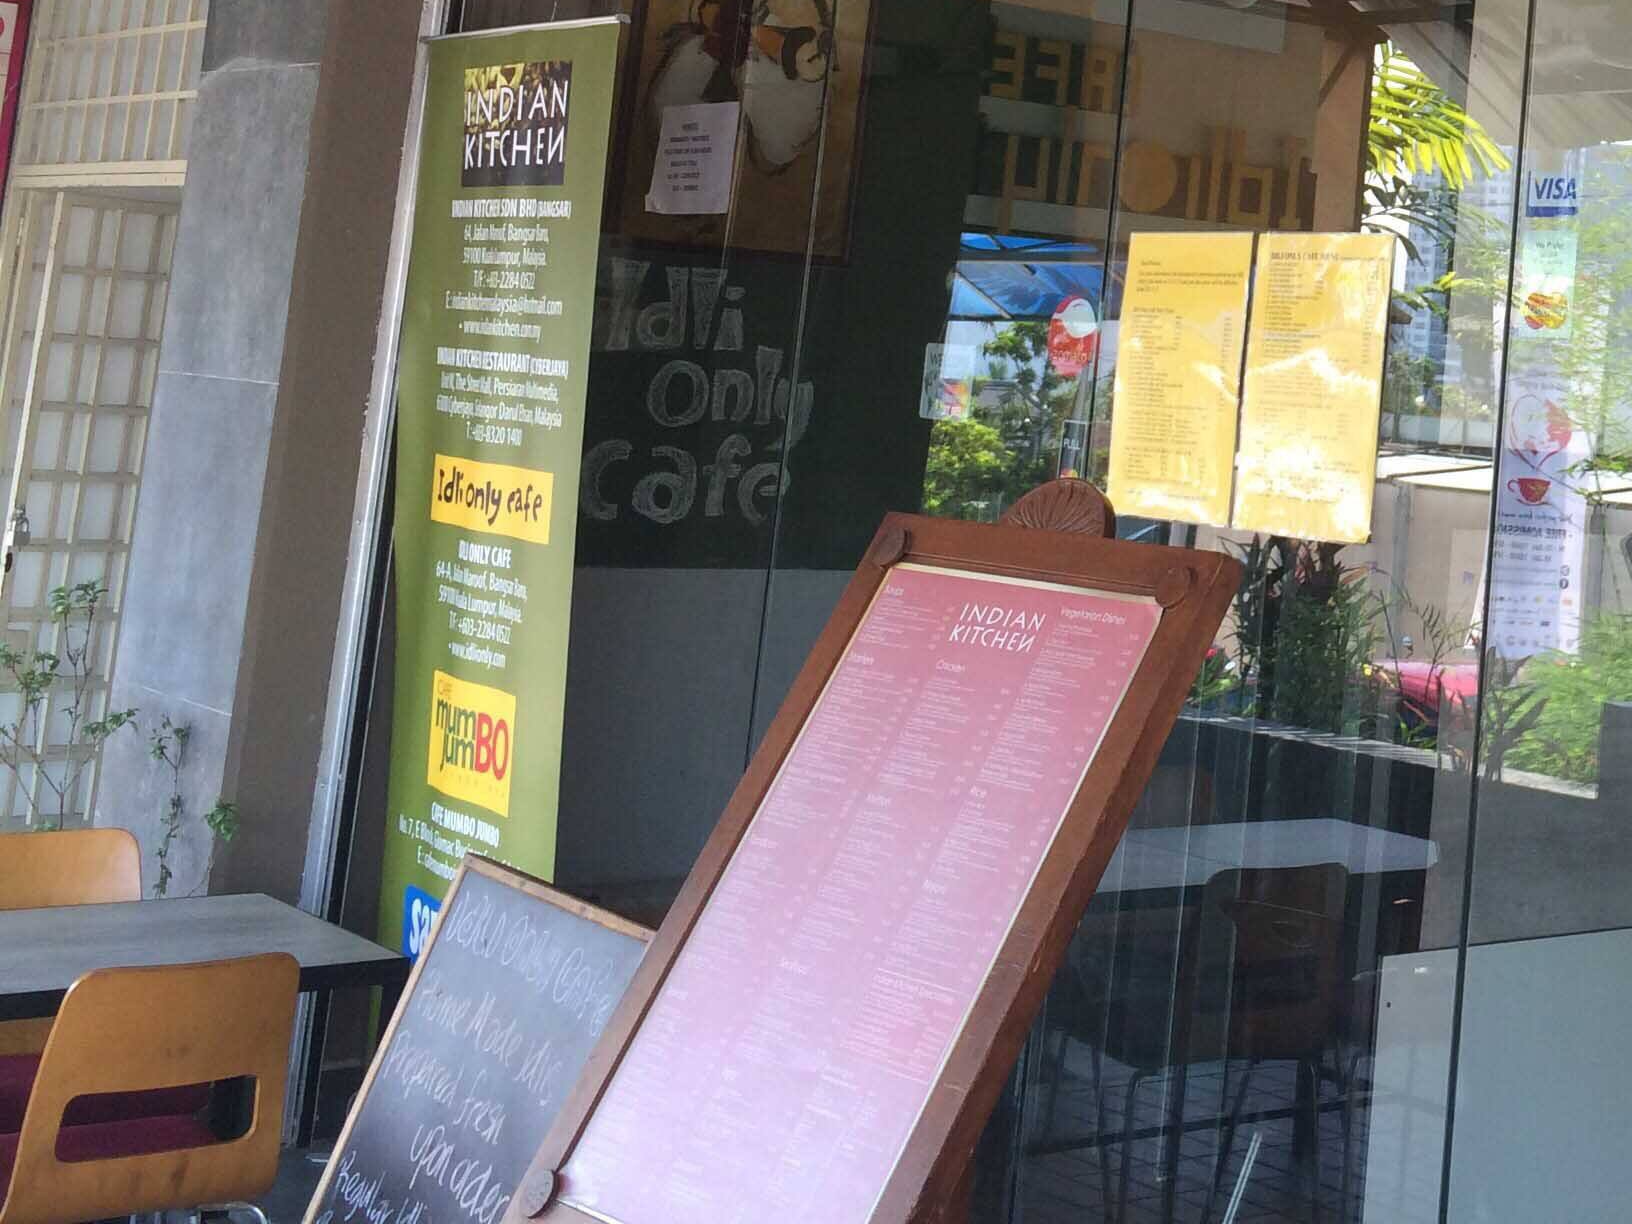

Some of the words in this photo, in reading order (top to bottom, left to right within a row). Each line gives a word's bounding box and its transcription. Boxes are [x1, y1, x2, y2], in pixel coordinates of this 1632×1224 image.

[466, 80, 569, 126] INDIAN
[464, 126, 565, 170] KITCHEN
[1535, 177, 1577, 201] VISA
[437, 466, 464, 504] Idli
[465, 481, 502, 526] only
[507, 484, 543, 522] cafe
[491, 546, 512, 569] CAFE
[959, 603, 1047, 632] INDIAN
[949, 624, 1036, 653] KITCHEN
